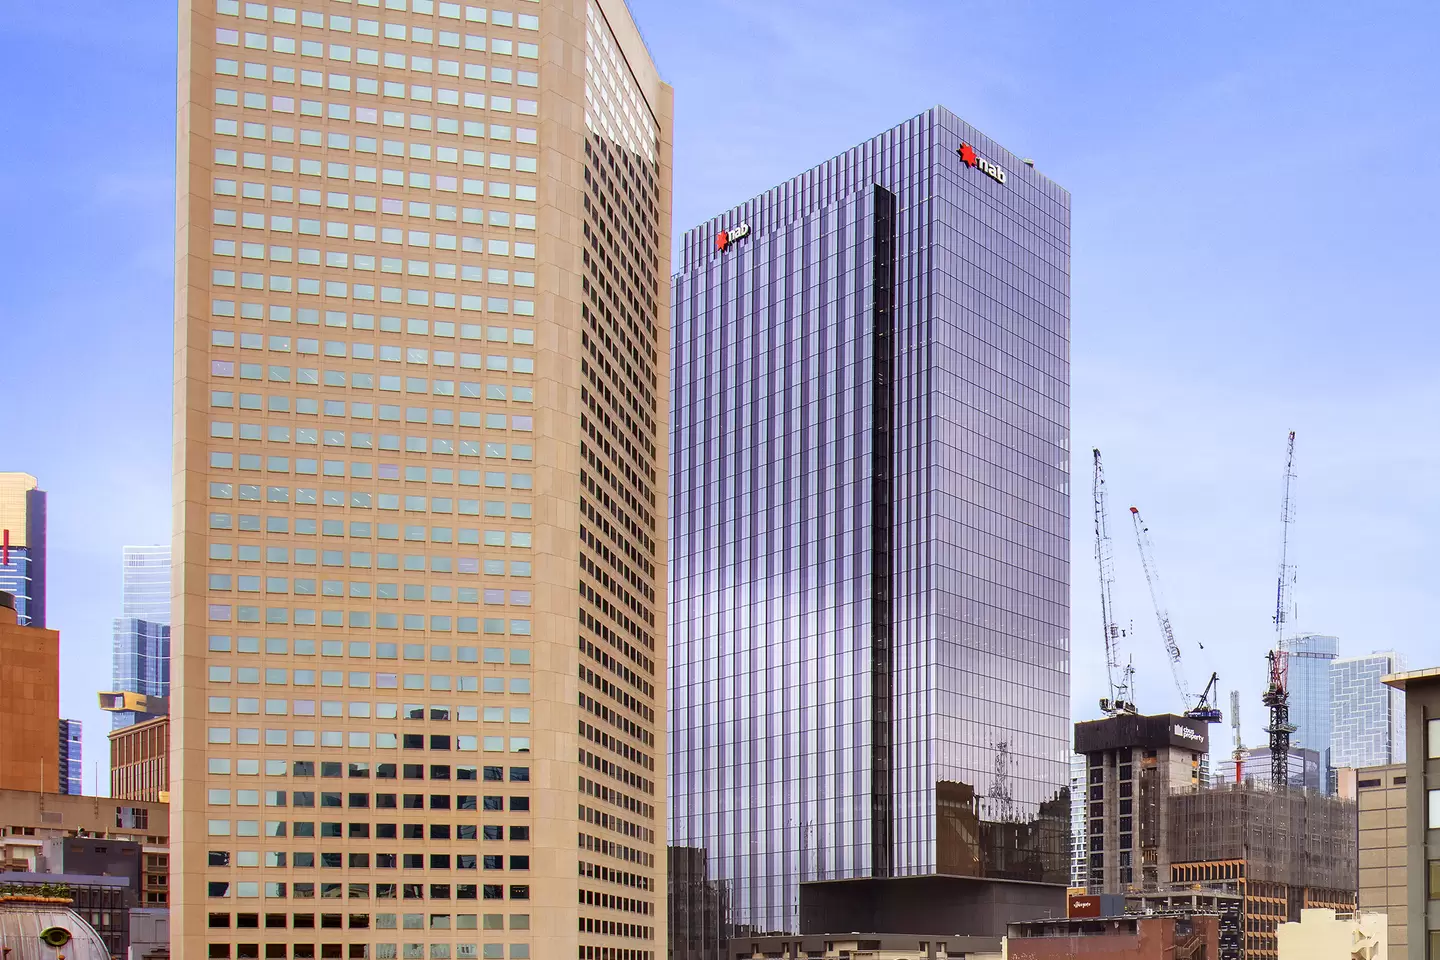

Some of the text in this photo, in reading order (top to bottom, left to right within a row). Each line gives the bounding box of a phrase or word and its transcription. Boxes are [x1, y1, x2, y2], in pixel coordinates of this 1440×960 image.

[976, 157, 1006, 183] nab
[728, 221, 750, 242] nab
[1183, 733, 1204, 743] property
